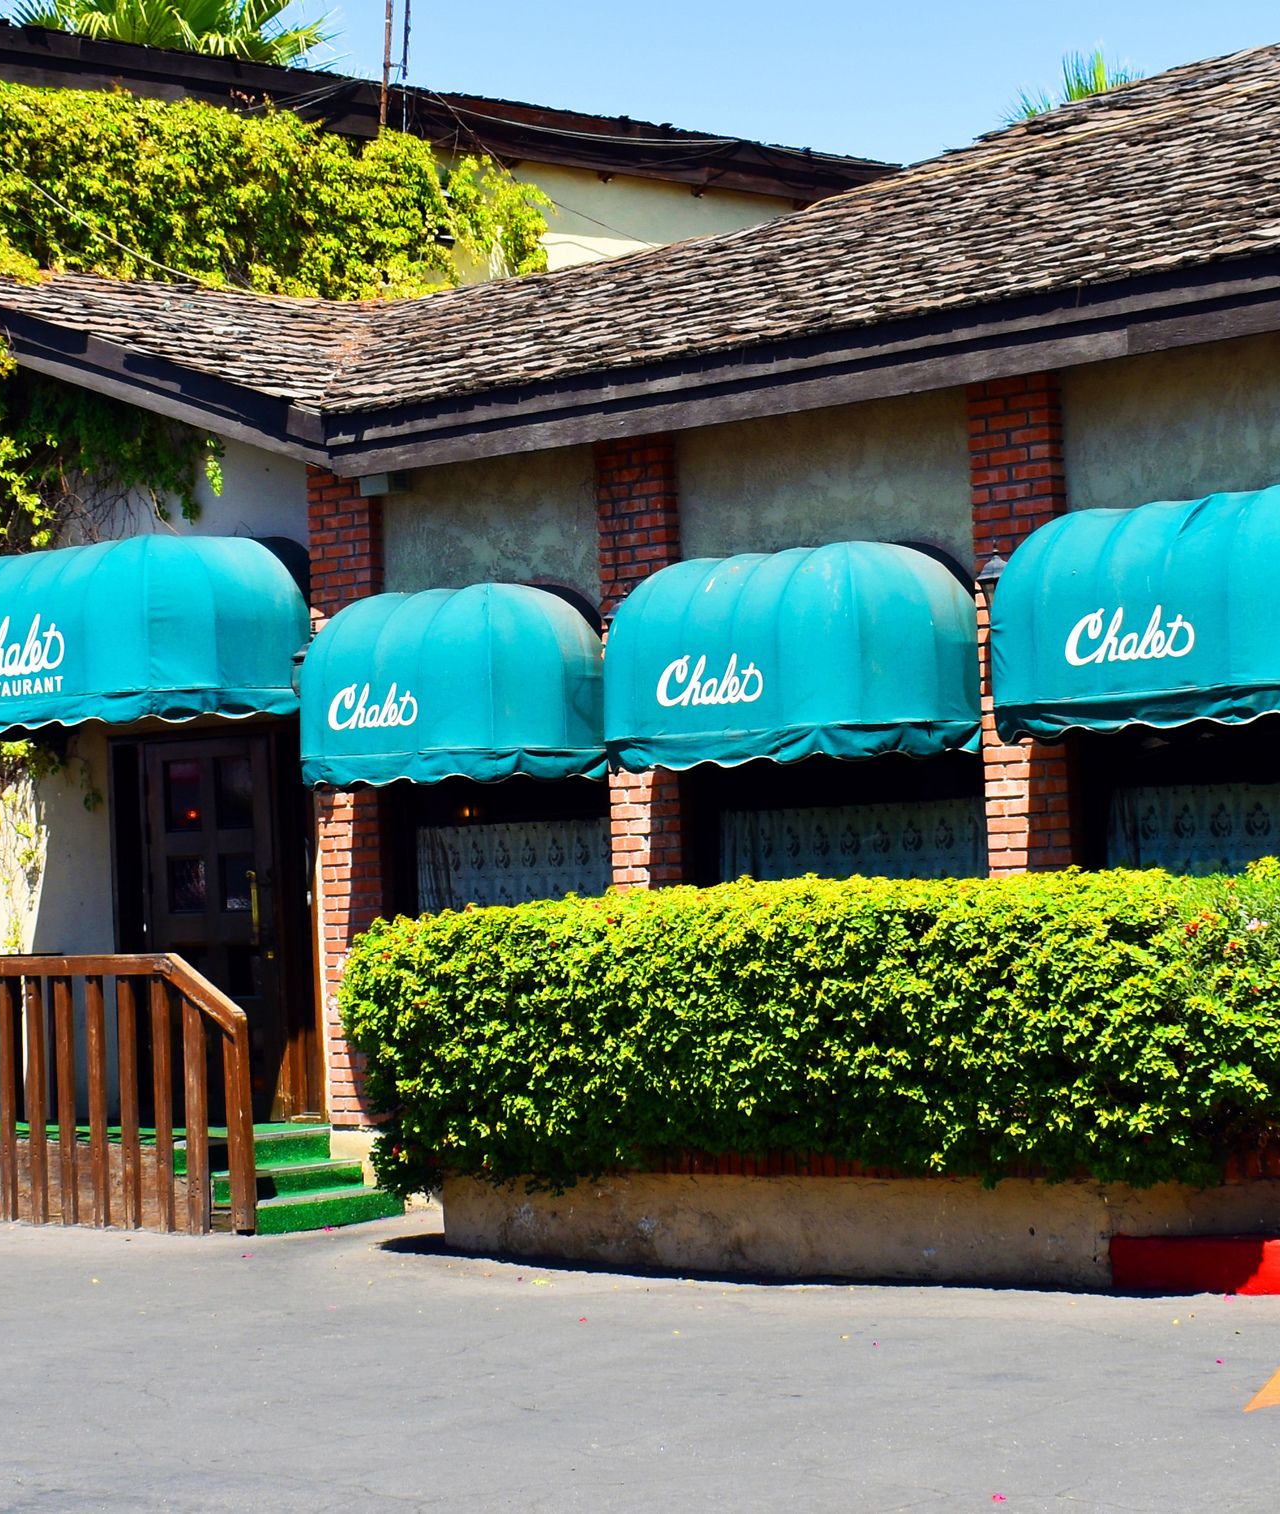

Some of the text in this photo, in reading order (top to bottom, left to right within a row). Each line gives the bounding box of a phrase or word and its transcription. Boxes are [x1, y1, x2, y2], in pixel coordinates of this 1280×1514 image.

[1064, 604, 1195, 666] Chalet
[327, 682, 418, 731] Chalet
[656, 653, 763, 707] Chalet
